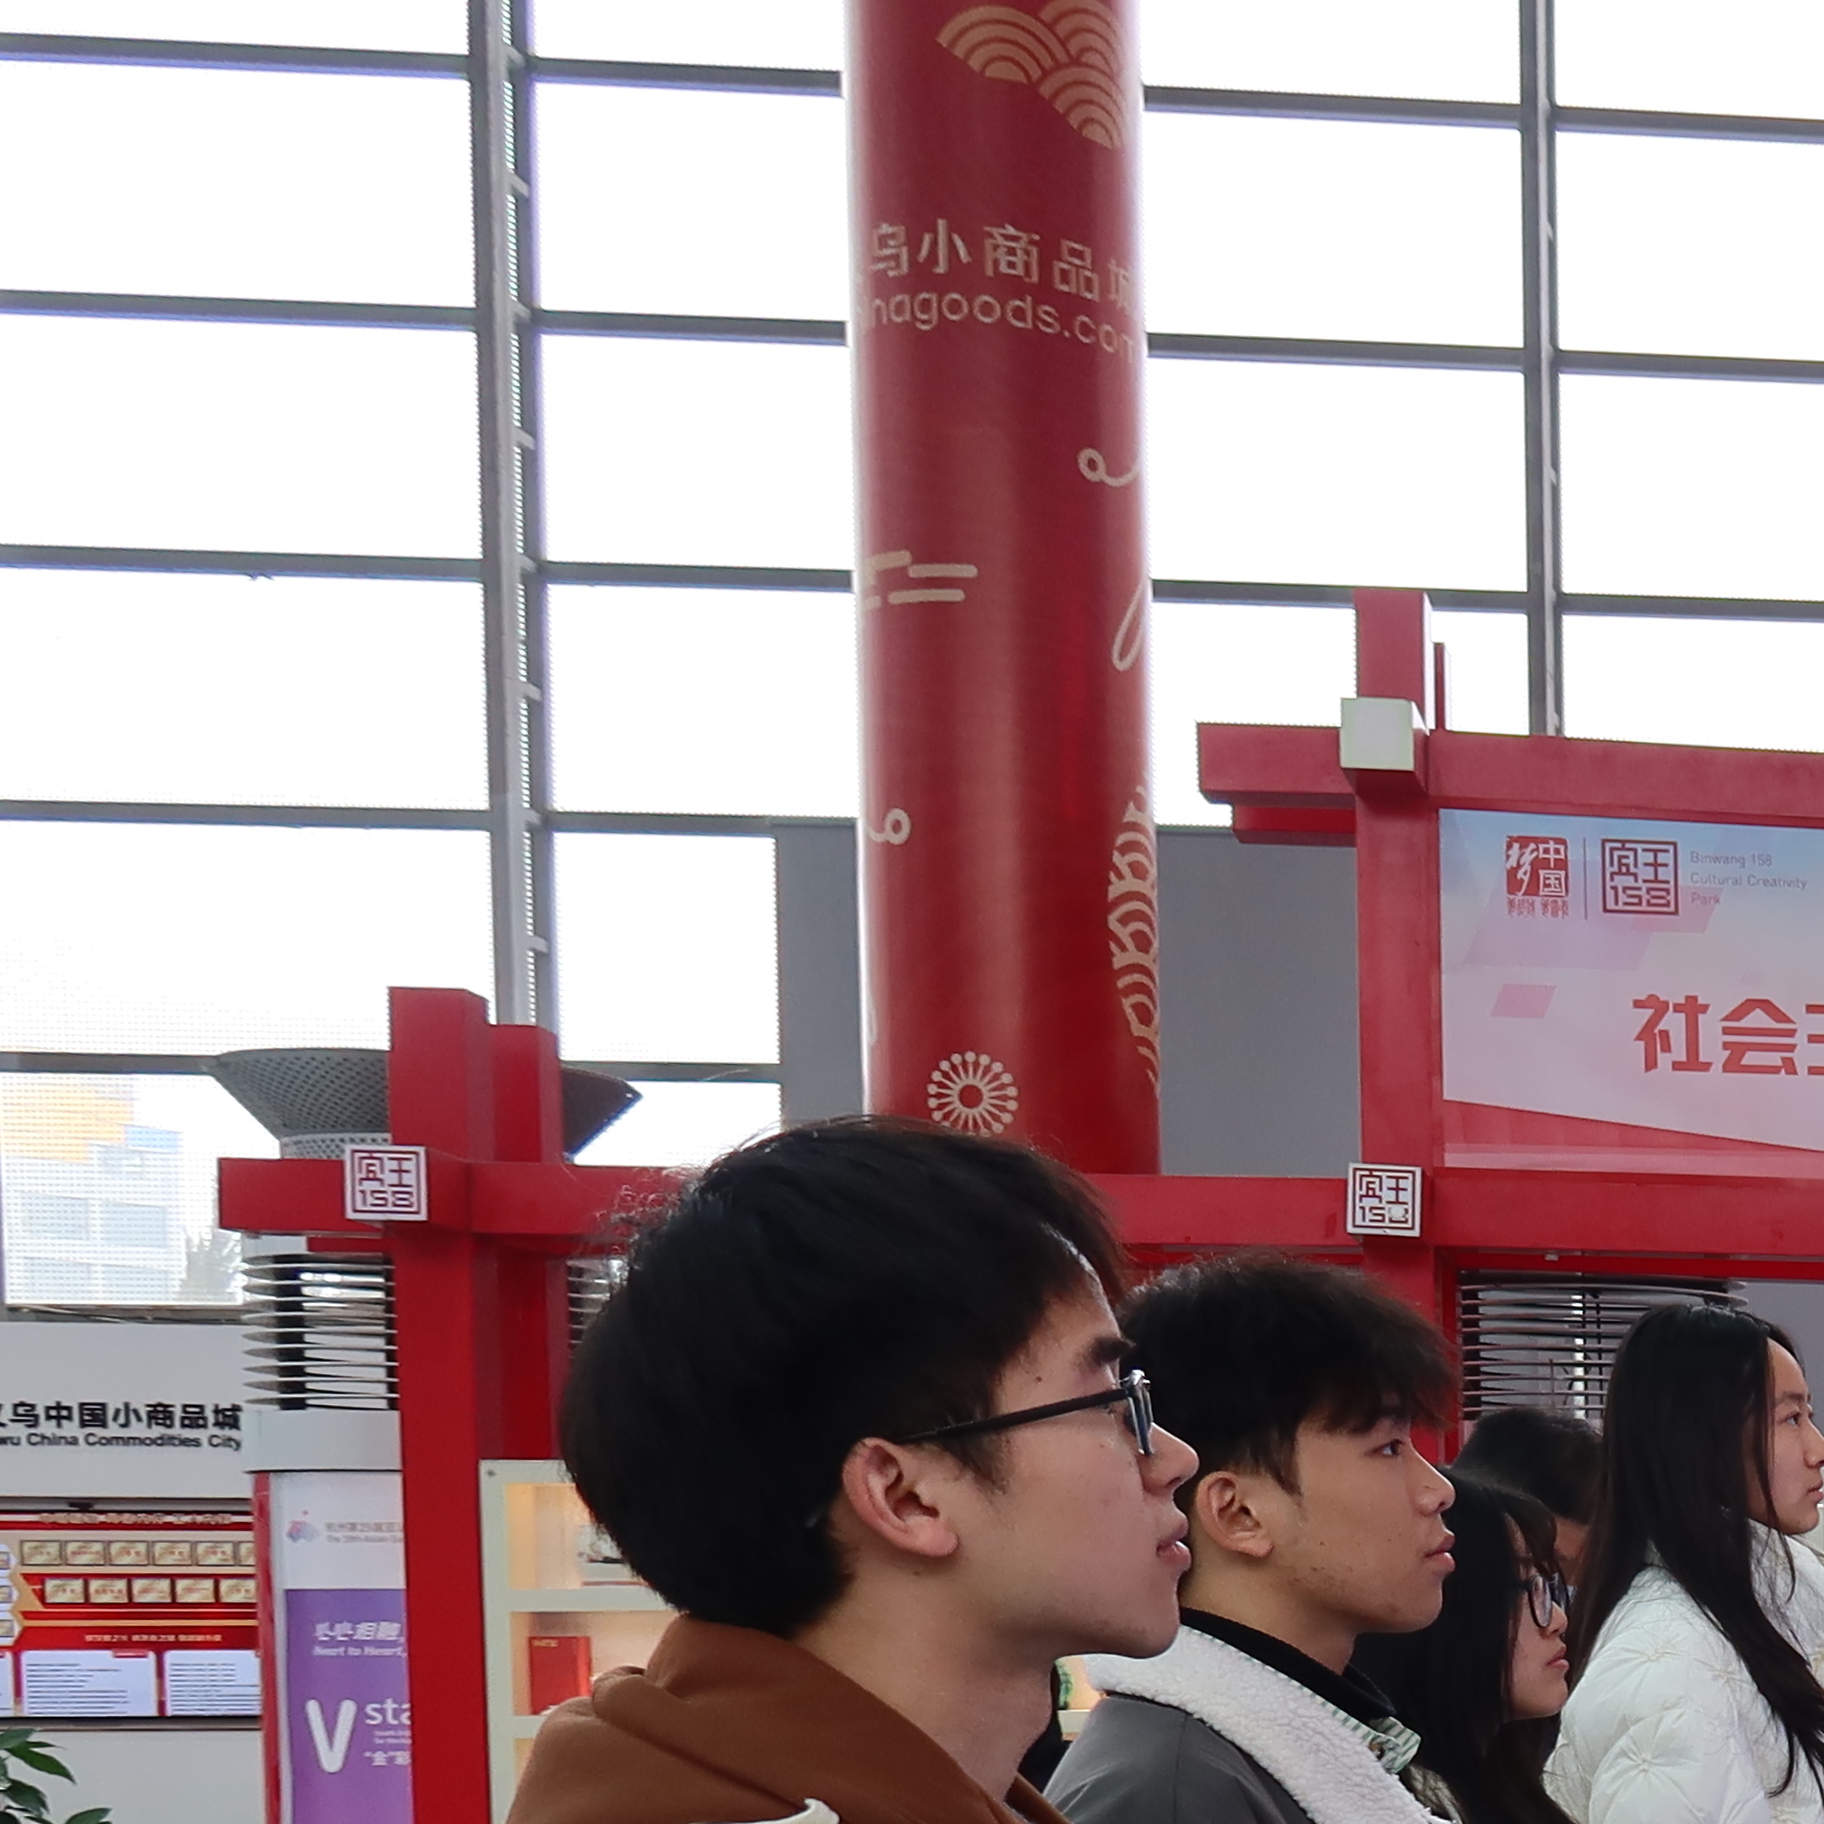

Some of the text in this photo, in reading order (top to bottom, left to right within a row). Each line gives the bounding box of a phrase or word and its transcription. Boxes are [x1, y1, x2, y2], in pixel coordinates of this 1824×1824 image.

[1690, 850, 1773, 868] Binwang 158
[1690, 873, 1807, 891] Cultural Creativity
[1690, 893, 1721, 906] Park
[26, 1433, 78, 1446] China
[85, 1433, 201, 1447] Commodities
[208, 1435, 241, 1451] City
